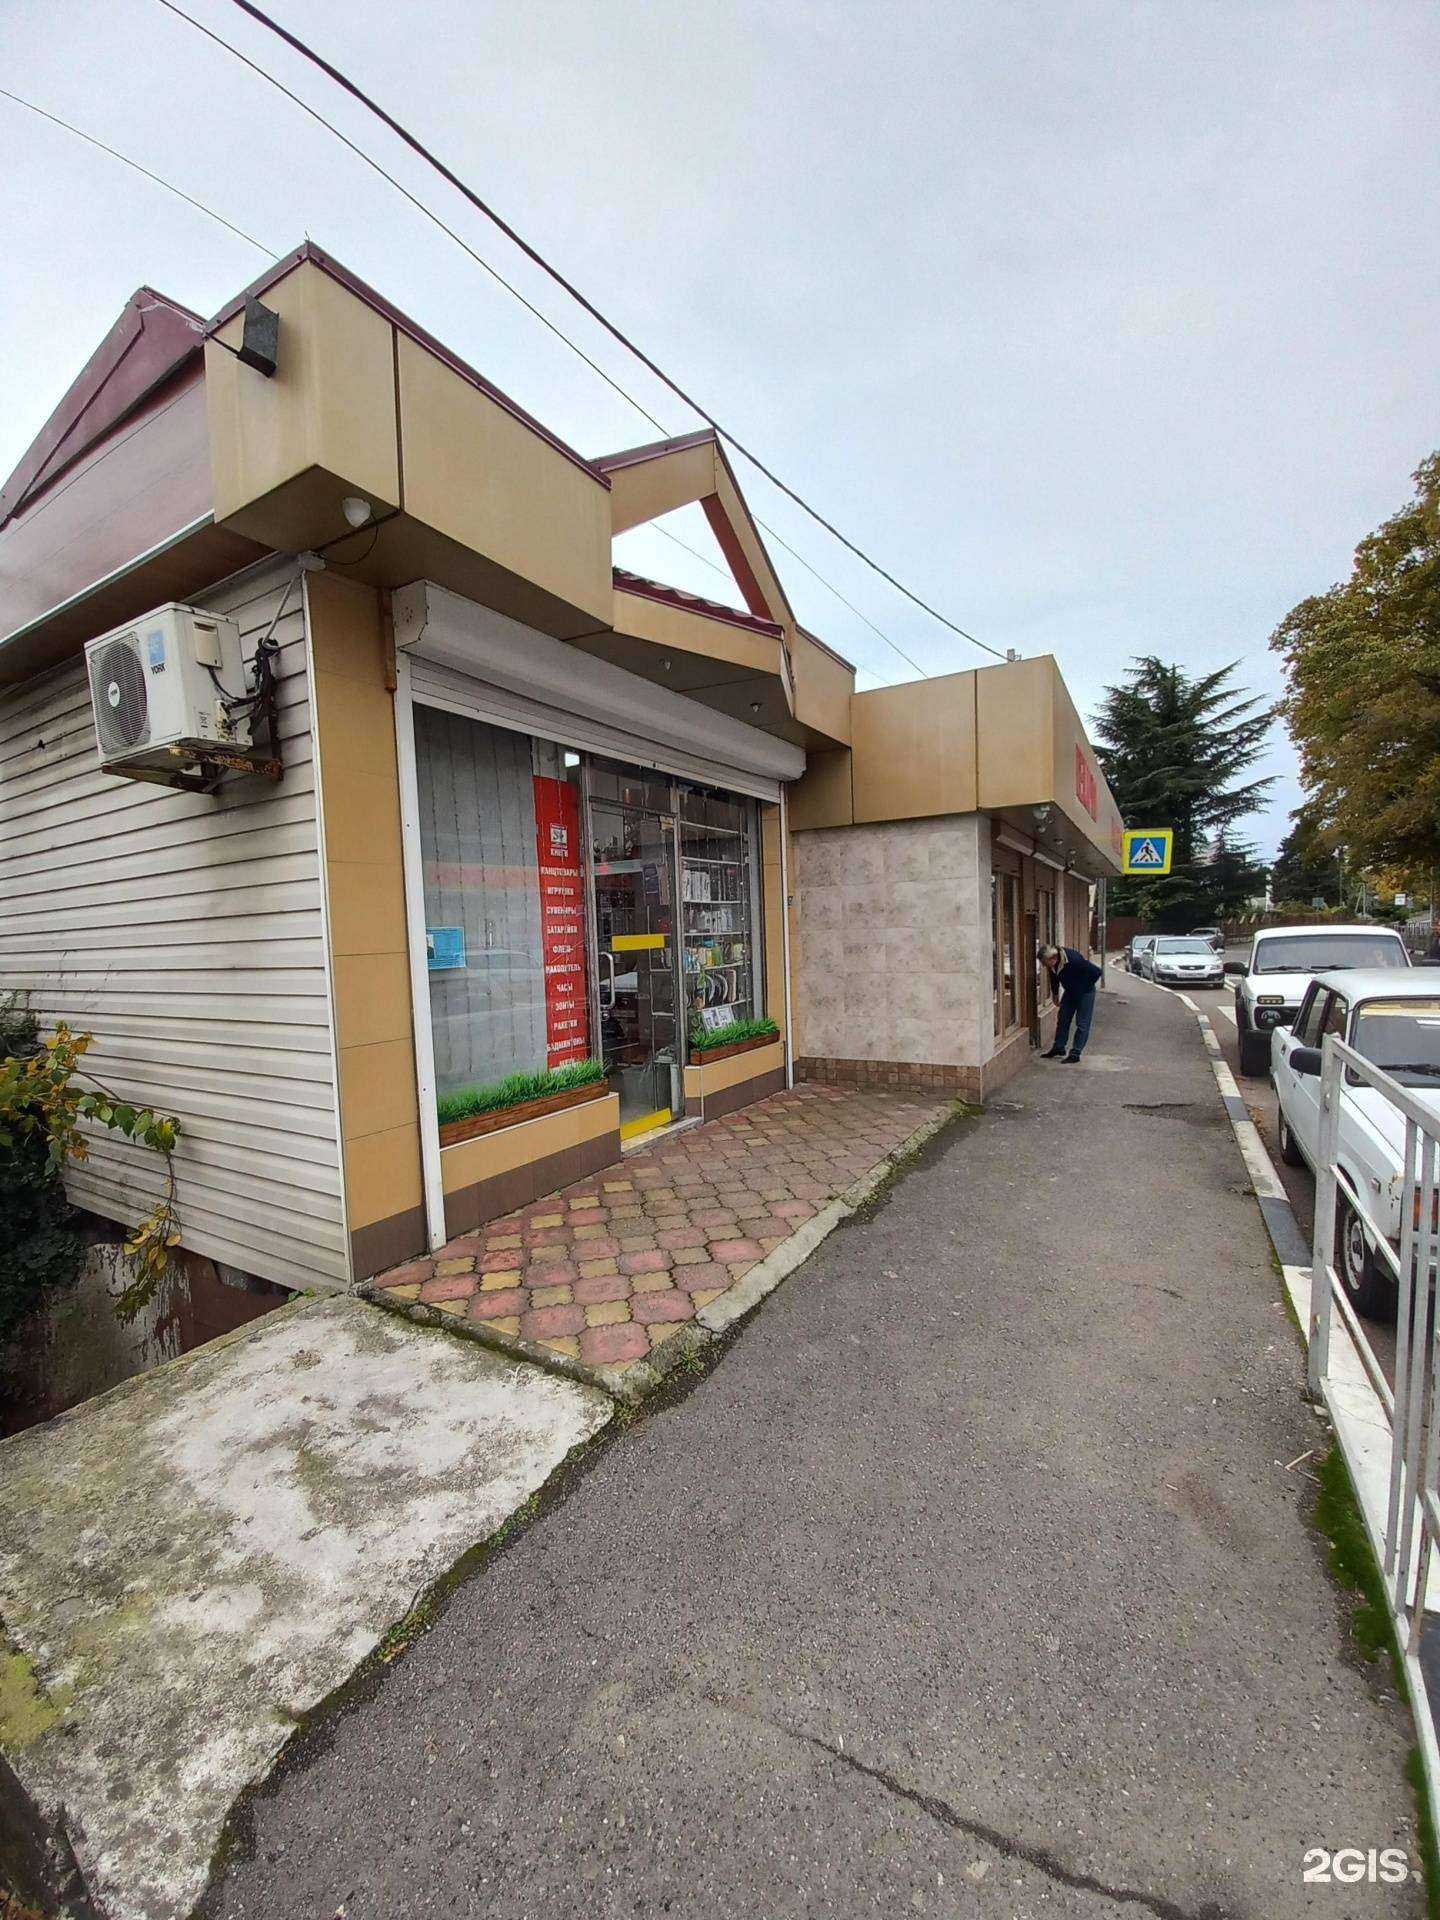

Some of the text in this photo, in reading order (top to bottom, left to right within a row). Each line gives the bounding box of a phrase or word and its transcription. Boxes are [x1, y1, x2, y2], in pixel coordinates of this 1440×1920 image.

[550, 848, 568, 857] КНИГИ
[541, 866, 578, 876] КАНЦТОВАРЫ
[546, 907, 576, 915] СУВЕНИРЫ
[547, 924, 578, 934] БАТАРЕЙКИ
[556, 983, 573, 992] ЧАСЫ
[555, 1000, 575, 1011] ЗОНТЫ
[553, 1019, 577, 1030] РАКЕТКИ
